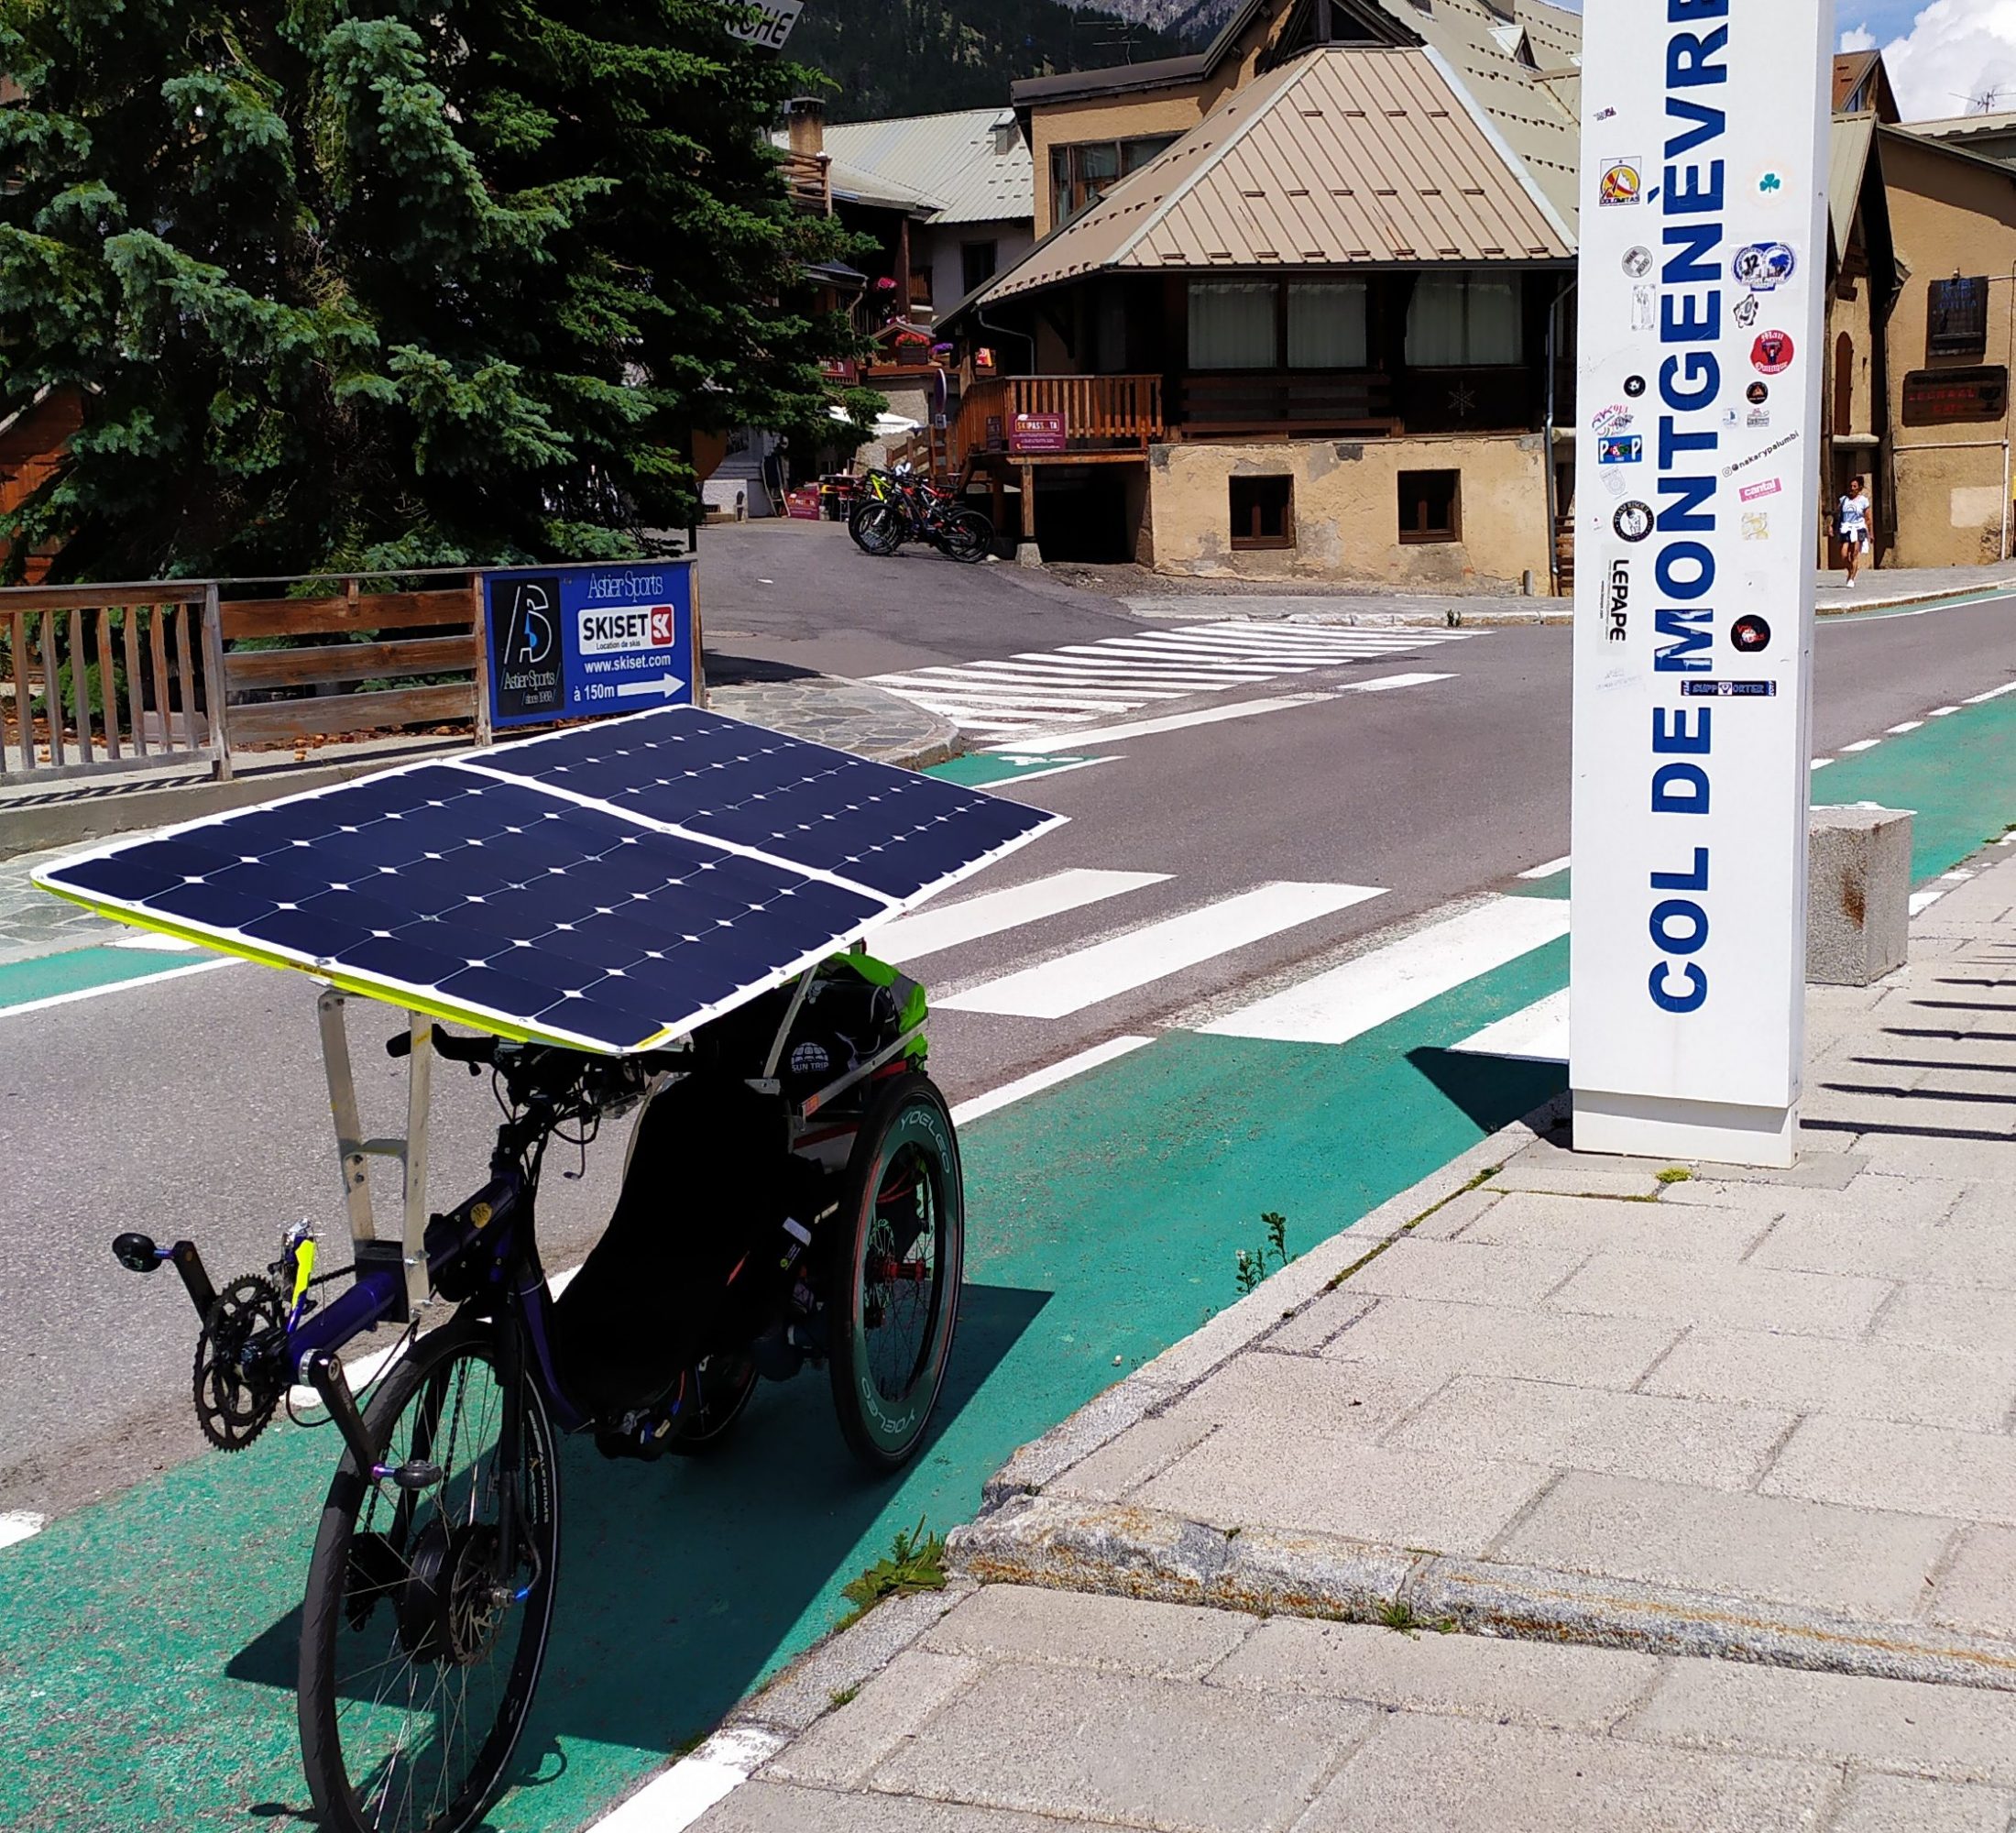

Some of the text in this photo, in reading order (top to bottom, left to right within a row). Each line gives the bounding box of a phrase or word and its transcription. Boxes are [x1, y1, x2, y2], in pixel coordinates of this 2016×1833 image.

[583, 613, 649, 642] SKISET
[597, 640, 620, 651] Location
[585, 654, 671, 674] www.skiset.com
[574, 684, 615, 702] à 150m
[1651, 707, 1711, 814] DE
[1649, 847, 1709, 1013] COL
[791, 1061, 829, 1072] SUN TRIP
